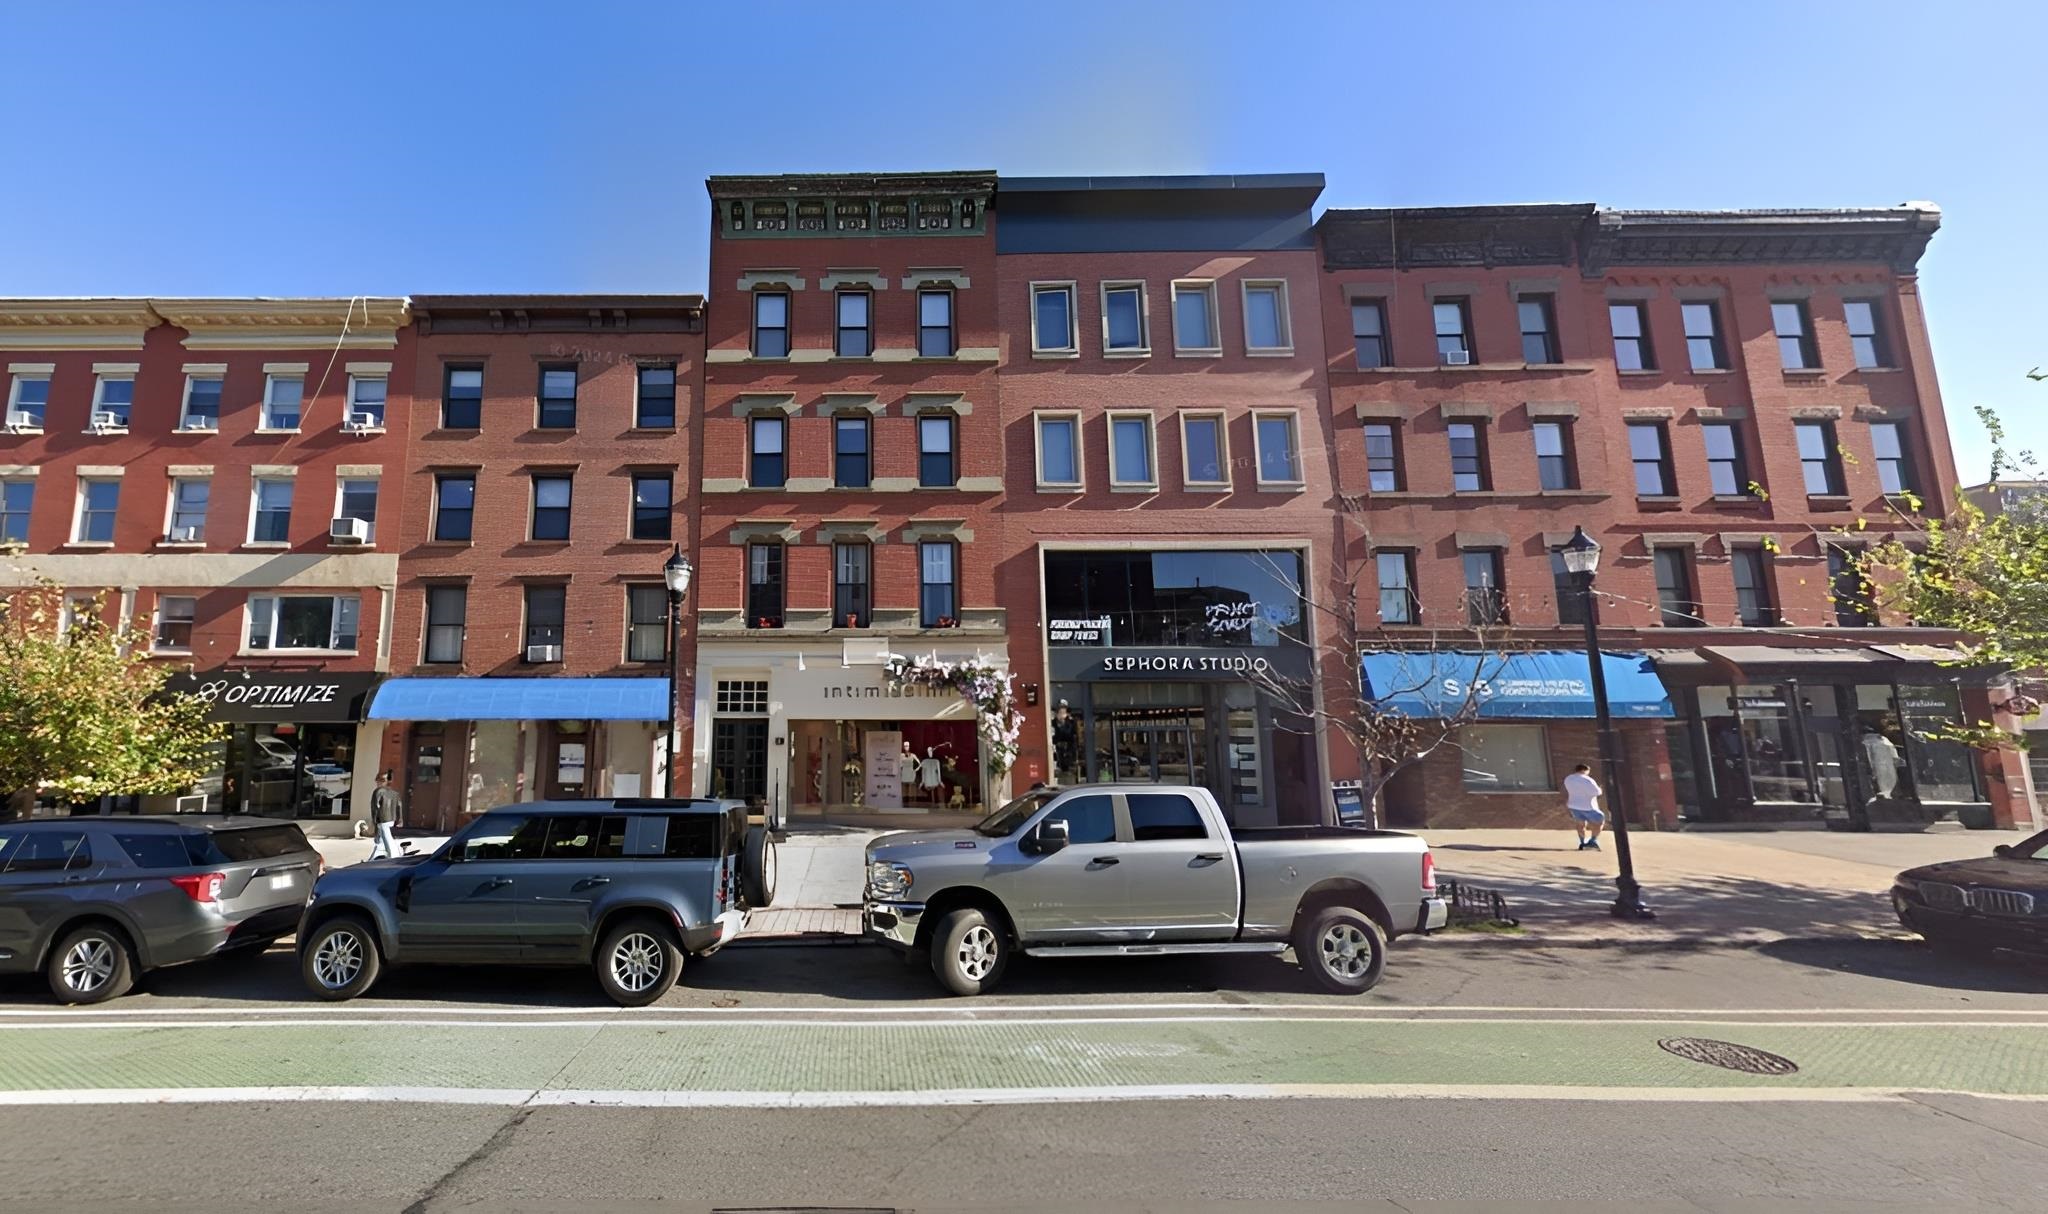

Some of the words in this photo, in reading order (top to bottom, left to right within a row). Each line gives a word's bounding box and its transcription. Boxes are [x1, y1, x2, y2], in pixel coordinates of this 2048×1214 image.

[1104, 657, 1194, 671] SEPHORA
[1200, 657, 1268, 671] STUDIO
[225, 685, 339, 703] OPTIMIZE
